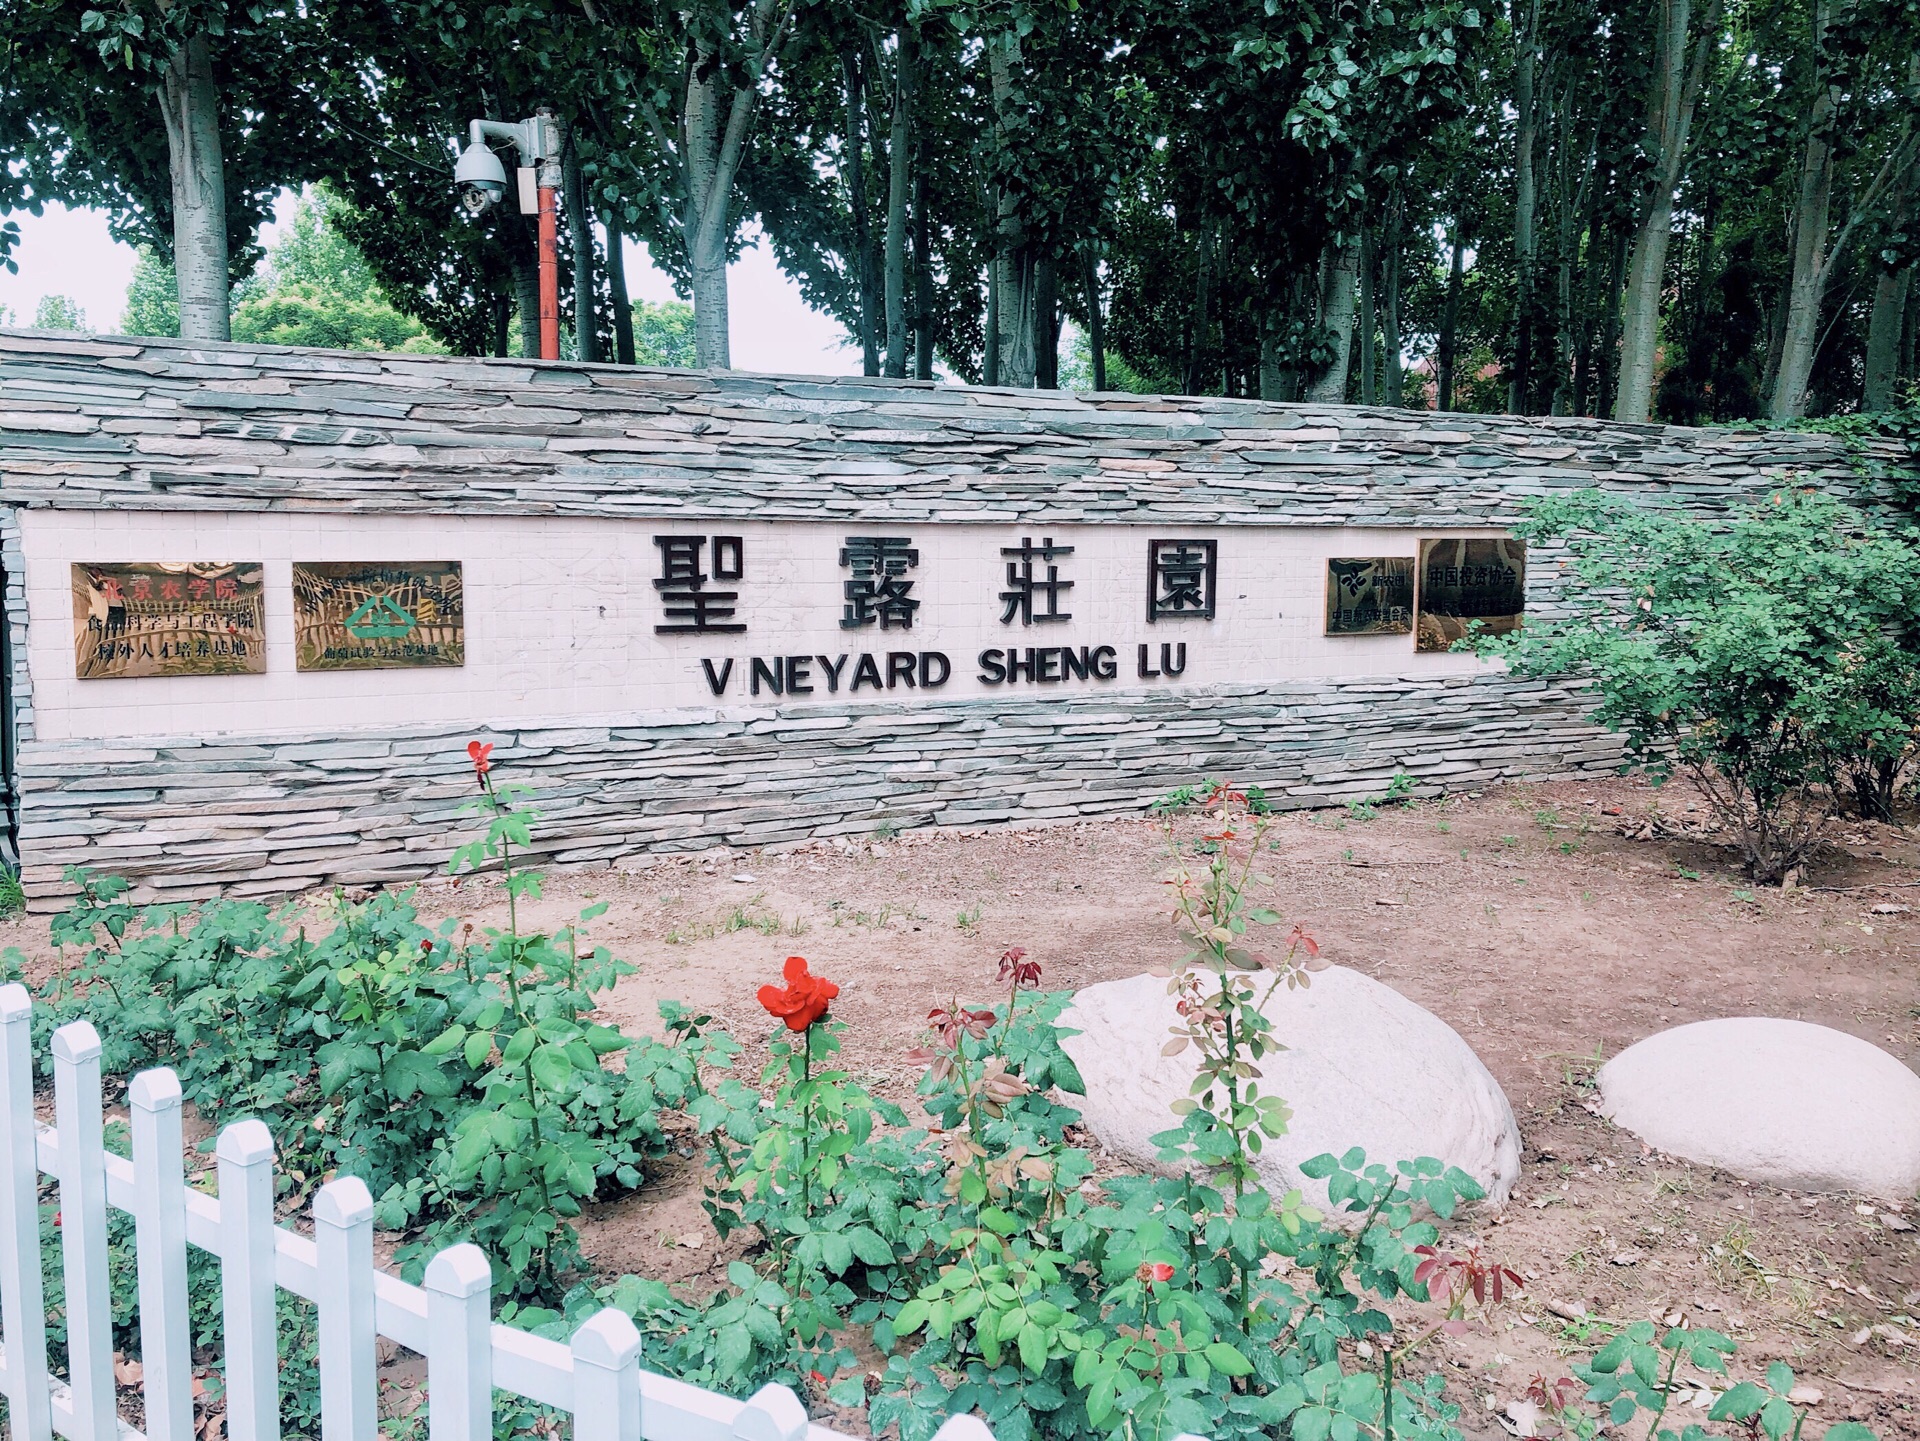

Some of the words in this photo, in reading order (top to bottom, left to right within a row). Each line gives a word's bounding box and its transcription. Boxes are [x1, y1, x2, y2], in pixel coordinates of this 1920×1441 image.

[102, 579, 238, 600] 北京农学院
[702, 651, 951, 696] VNEYARD
[977, 645, 1117, 686] SHENG
[1138, 642, 1187, 678] LU
